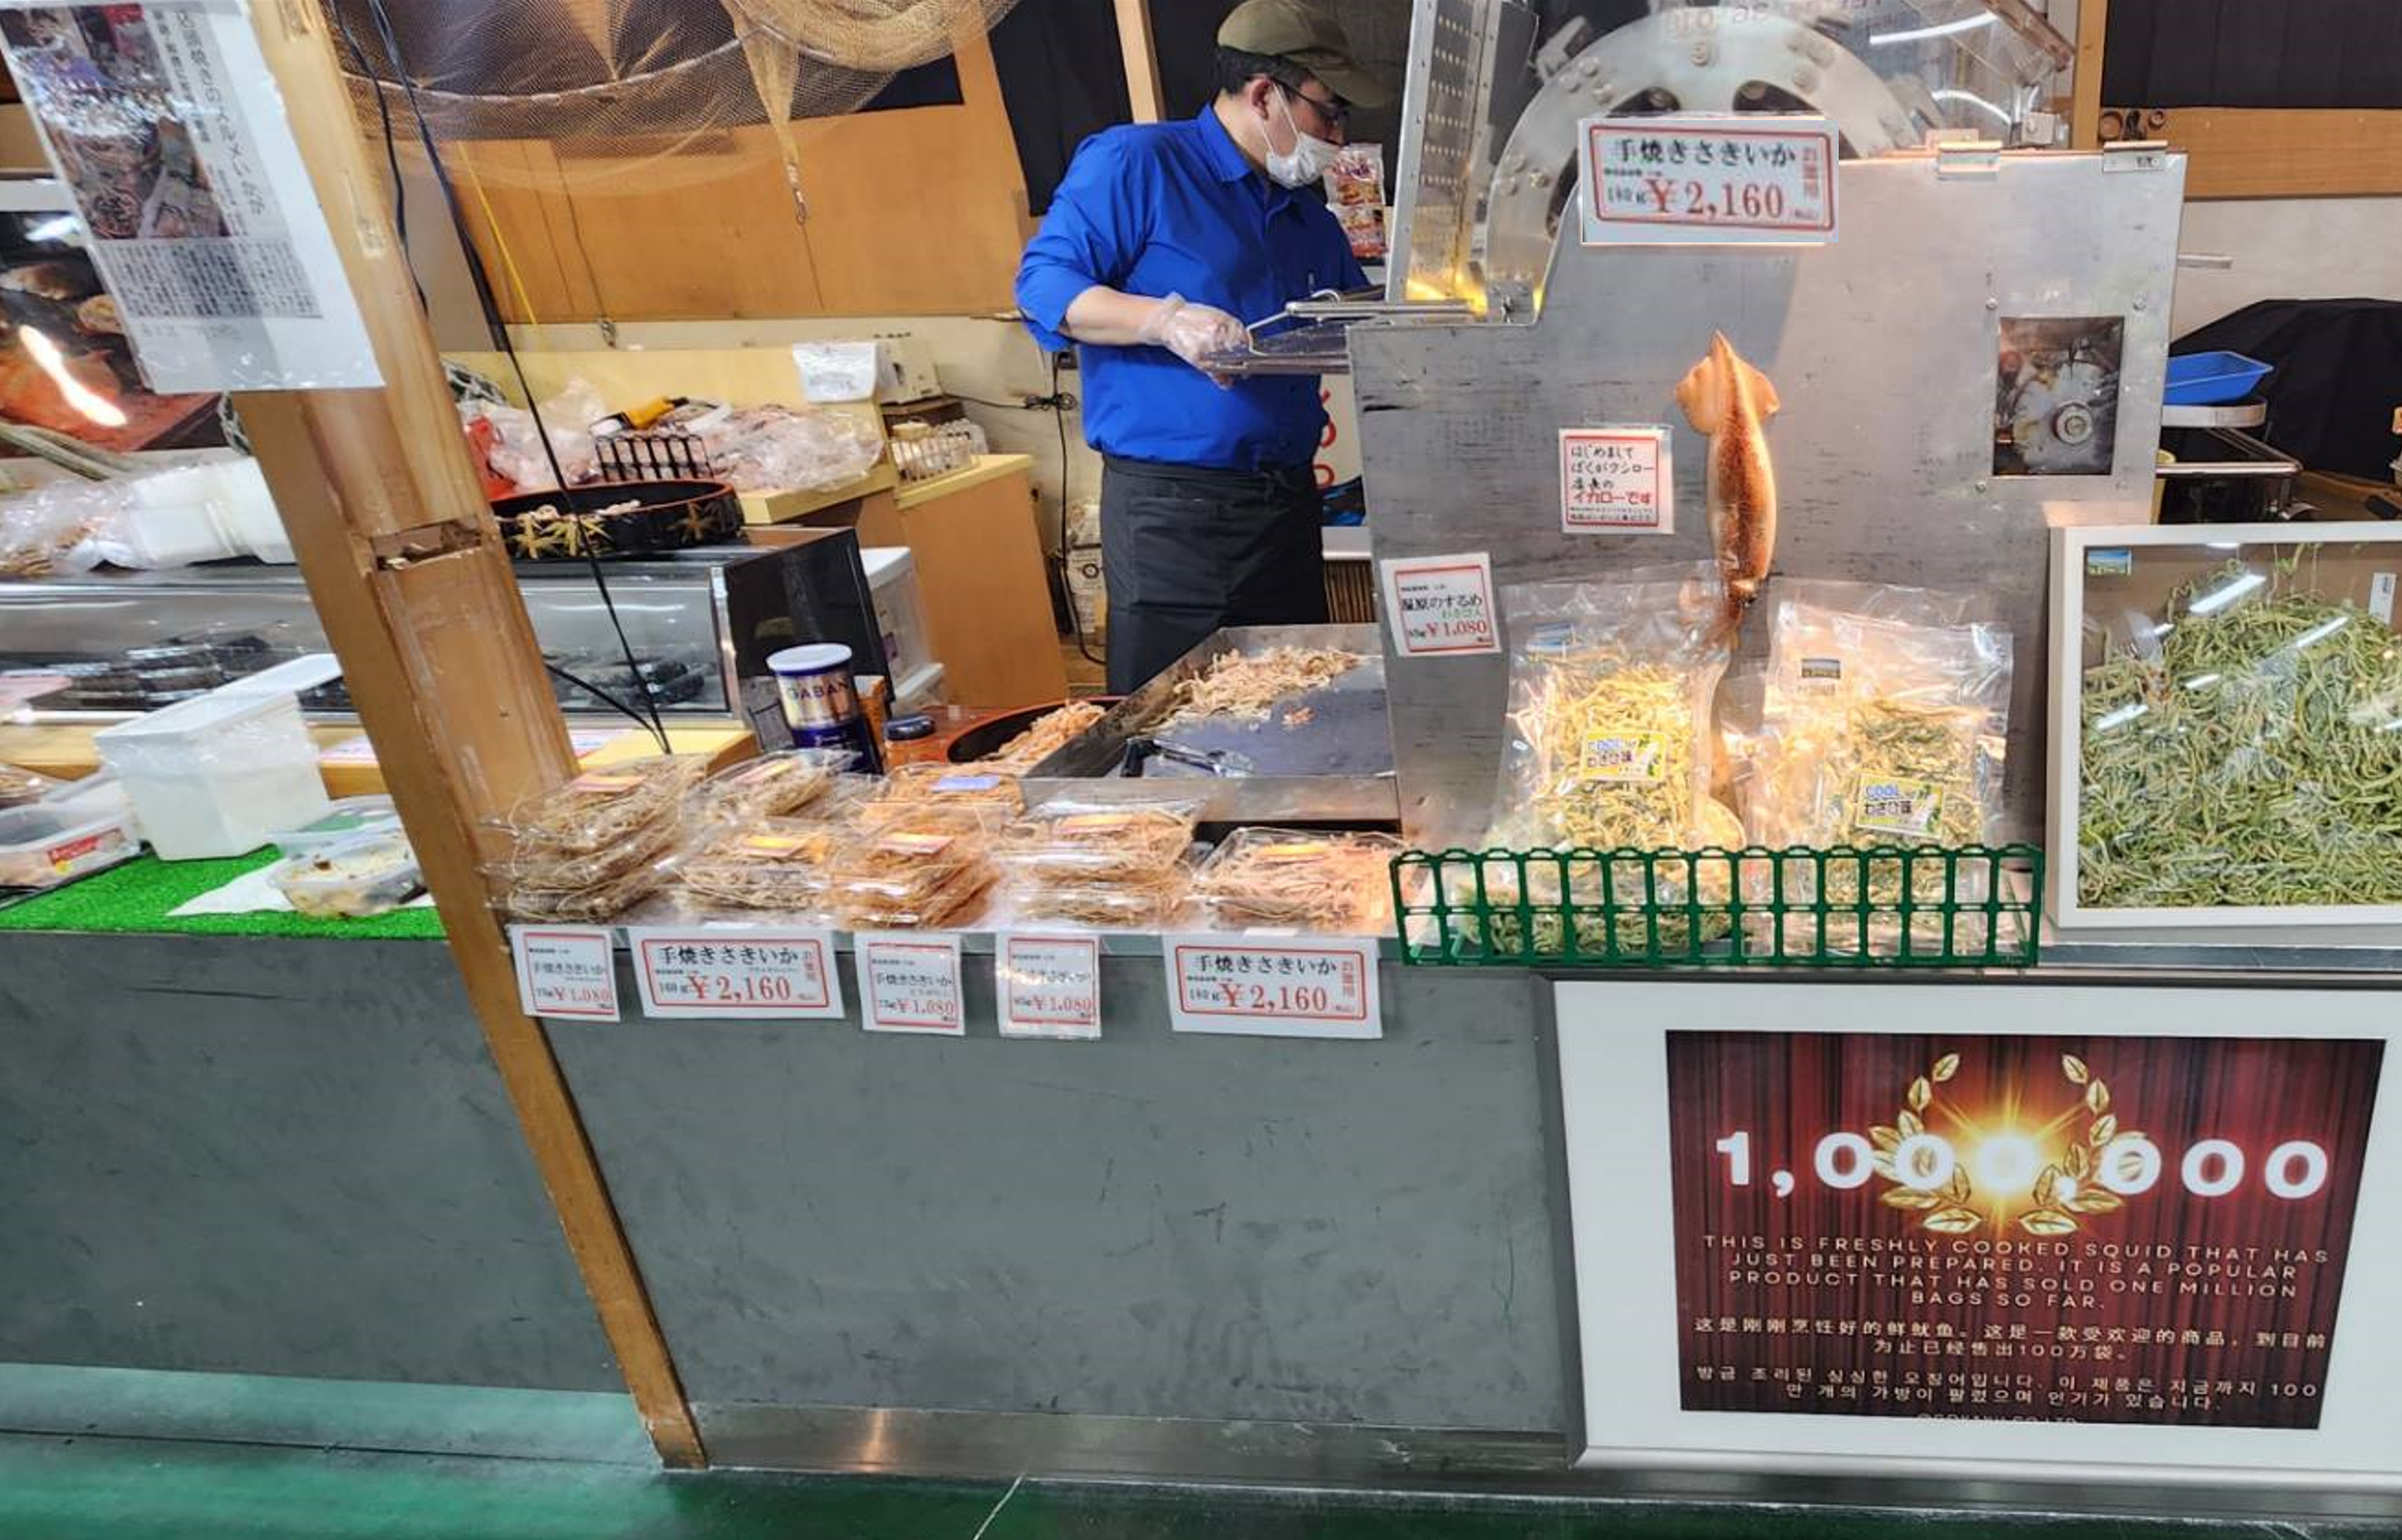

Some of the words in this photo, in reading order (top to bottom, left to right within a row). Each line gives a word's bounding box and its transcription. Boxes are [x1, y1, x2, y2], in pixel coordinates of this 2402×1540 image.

[1612, 138, 1796, 166] 手焼きさきいか
[1646, 178, 1784, 220] ¥2,160
[1571, 443, 1633, 459] はじめまして
[1572, 490, 1651, 505] イカローです
[659, 944, 798, 966] 手焼きさきいか
[1193, 955, 1337, 975] 手焼きさきいか
[686, 974, 791, 1004] ¥2,160
[1220, 982, 1327, 1013] ¥2,160
[1715, 1129, 2329, 1199] 1,000,000
[1704, 1235, 1766, 1250] THIS
[1780, 1237, 1804, 1250] IS
[1819, 1237, 1938, 1253] FRESHLY
[1952, 1240, 2070, 1257] COOKED
[2085, 1243, 2173, 1259] SQUID
[2187, 1246, 2260, 1261] THAT
[2274, 1248, 2328, 1263] HAS
[1732, 1253, 1796, 1266] JUST
[1811, 1254, 1878, 1268] BEEN
[1893, 1256, 2044, 1273] PREPARED.
[2060, 1260, 2083, 1273] IT
[2099, 1261, 2123, 1275] IS
[2137, 1262, 2152, 1275] A
[2168, 1263, 2297, 1279] POPULAR
[1730, 1270, 1860, 1287] PRODUCT
[1874, 1274, 1942, 1287] THAT
[1957, 1275, 2008, 1290] HAS
[2023, 1277, 2094, 1292] SOLD
[2110, 1280, 2164, 1294] ONE
[2179, 1281, 2297, 1298] MILLION
[1911, 1291, 1982, 1305] BAGS
[1997, 1293, 2031, 1307] SO
[2047, 1295, 2105, 1310] FAR.
[1696, 1365, 1737, 1381] 방금
[1751, 1367, 1813, 1383] 조리된
[2059, 1375, 2076, 1390] 이
[2090, 1377, 2156, 1392] 제품은
[2170, 1379, 2257, 1397] 지금까지
[2271, 1384, 2318, 1398] 100
[1817, 1385, 1856, 1399] 개의
[1870, 1385, 1933, 1403] 가방이
[1948, 1387, 2033, 1405] 팔렸으며
[2048, 1390, 2110, 1407] 인기가
